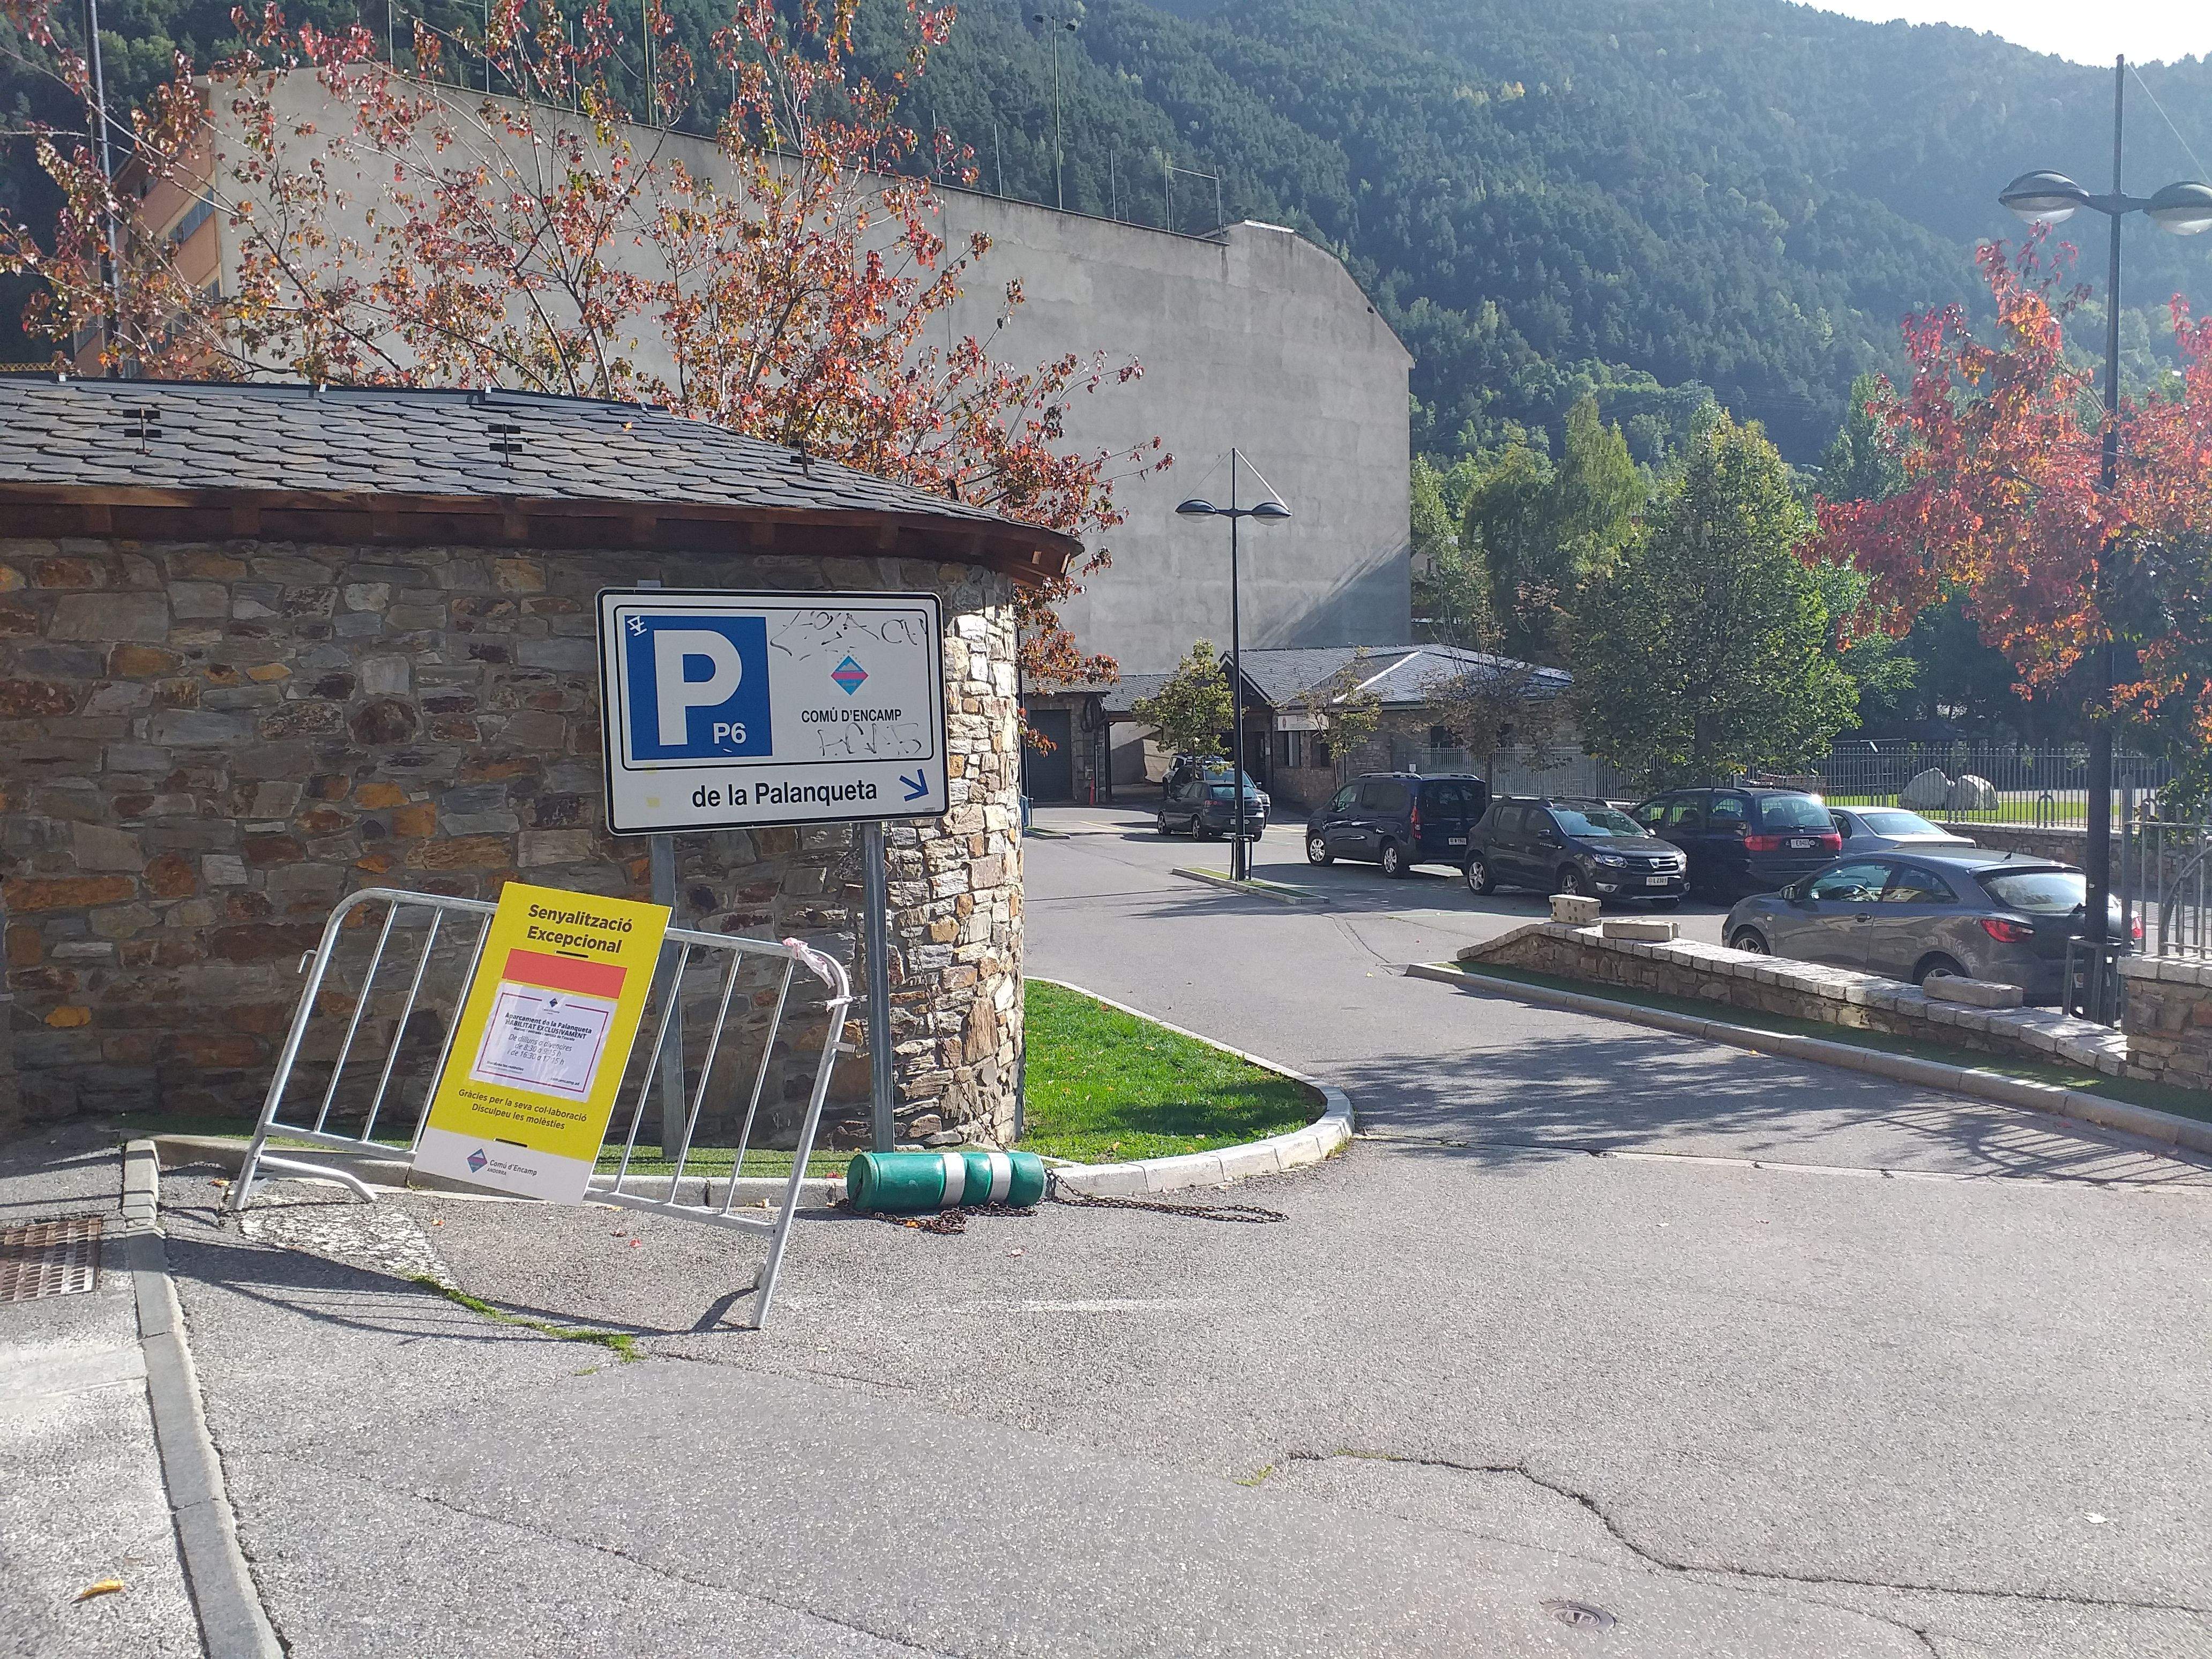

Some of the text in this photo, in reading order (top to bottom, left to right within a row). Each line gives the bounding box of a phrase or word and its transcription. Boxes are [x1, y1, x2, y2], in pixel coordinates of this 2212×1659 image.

[654, 630, 742, 745] P
[802, 707, 901, 722] COMÚ D'ENCAMP
[713, 722, 746, 744] P6
[692, 780, 877, 807] de la Palanqueta
[528, 904, 632, 932] Senyalització
[527, 925, 622, 953] Excepcional
[505, 1012, 541, 1024] Aparcament
[557, 1022, 592, 1034] Palanqueta
[505, 1019, 587, 1039] HABILITAT EXCLUSIVAMENT
[518, 1035, 538, 1045] dilluns
[544, 1041, 572, 1051] divendres
[524, 1044, 537, 1052] 8:30
[459, 1089, 487, 1101] Gràcies
[489, 1096, 503, 1104] per
[505, 1098, 512, 1106] la
[514, 1102, 532, 1110] seva
[472, 1103, 565, 1130] Disculpeu les molèsties
[487, 1168, 507, 1176] ANDORRA
[490, 1159, 537, 1176] Comú d'Encamp
